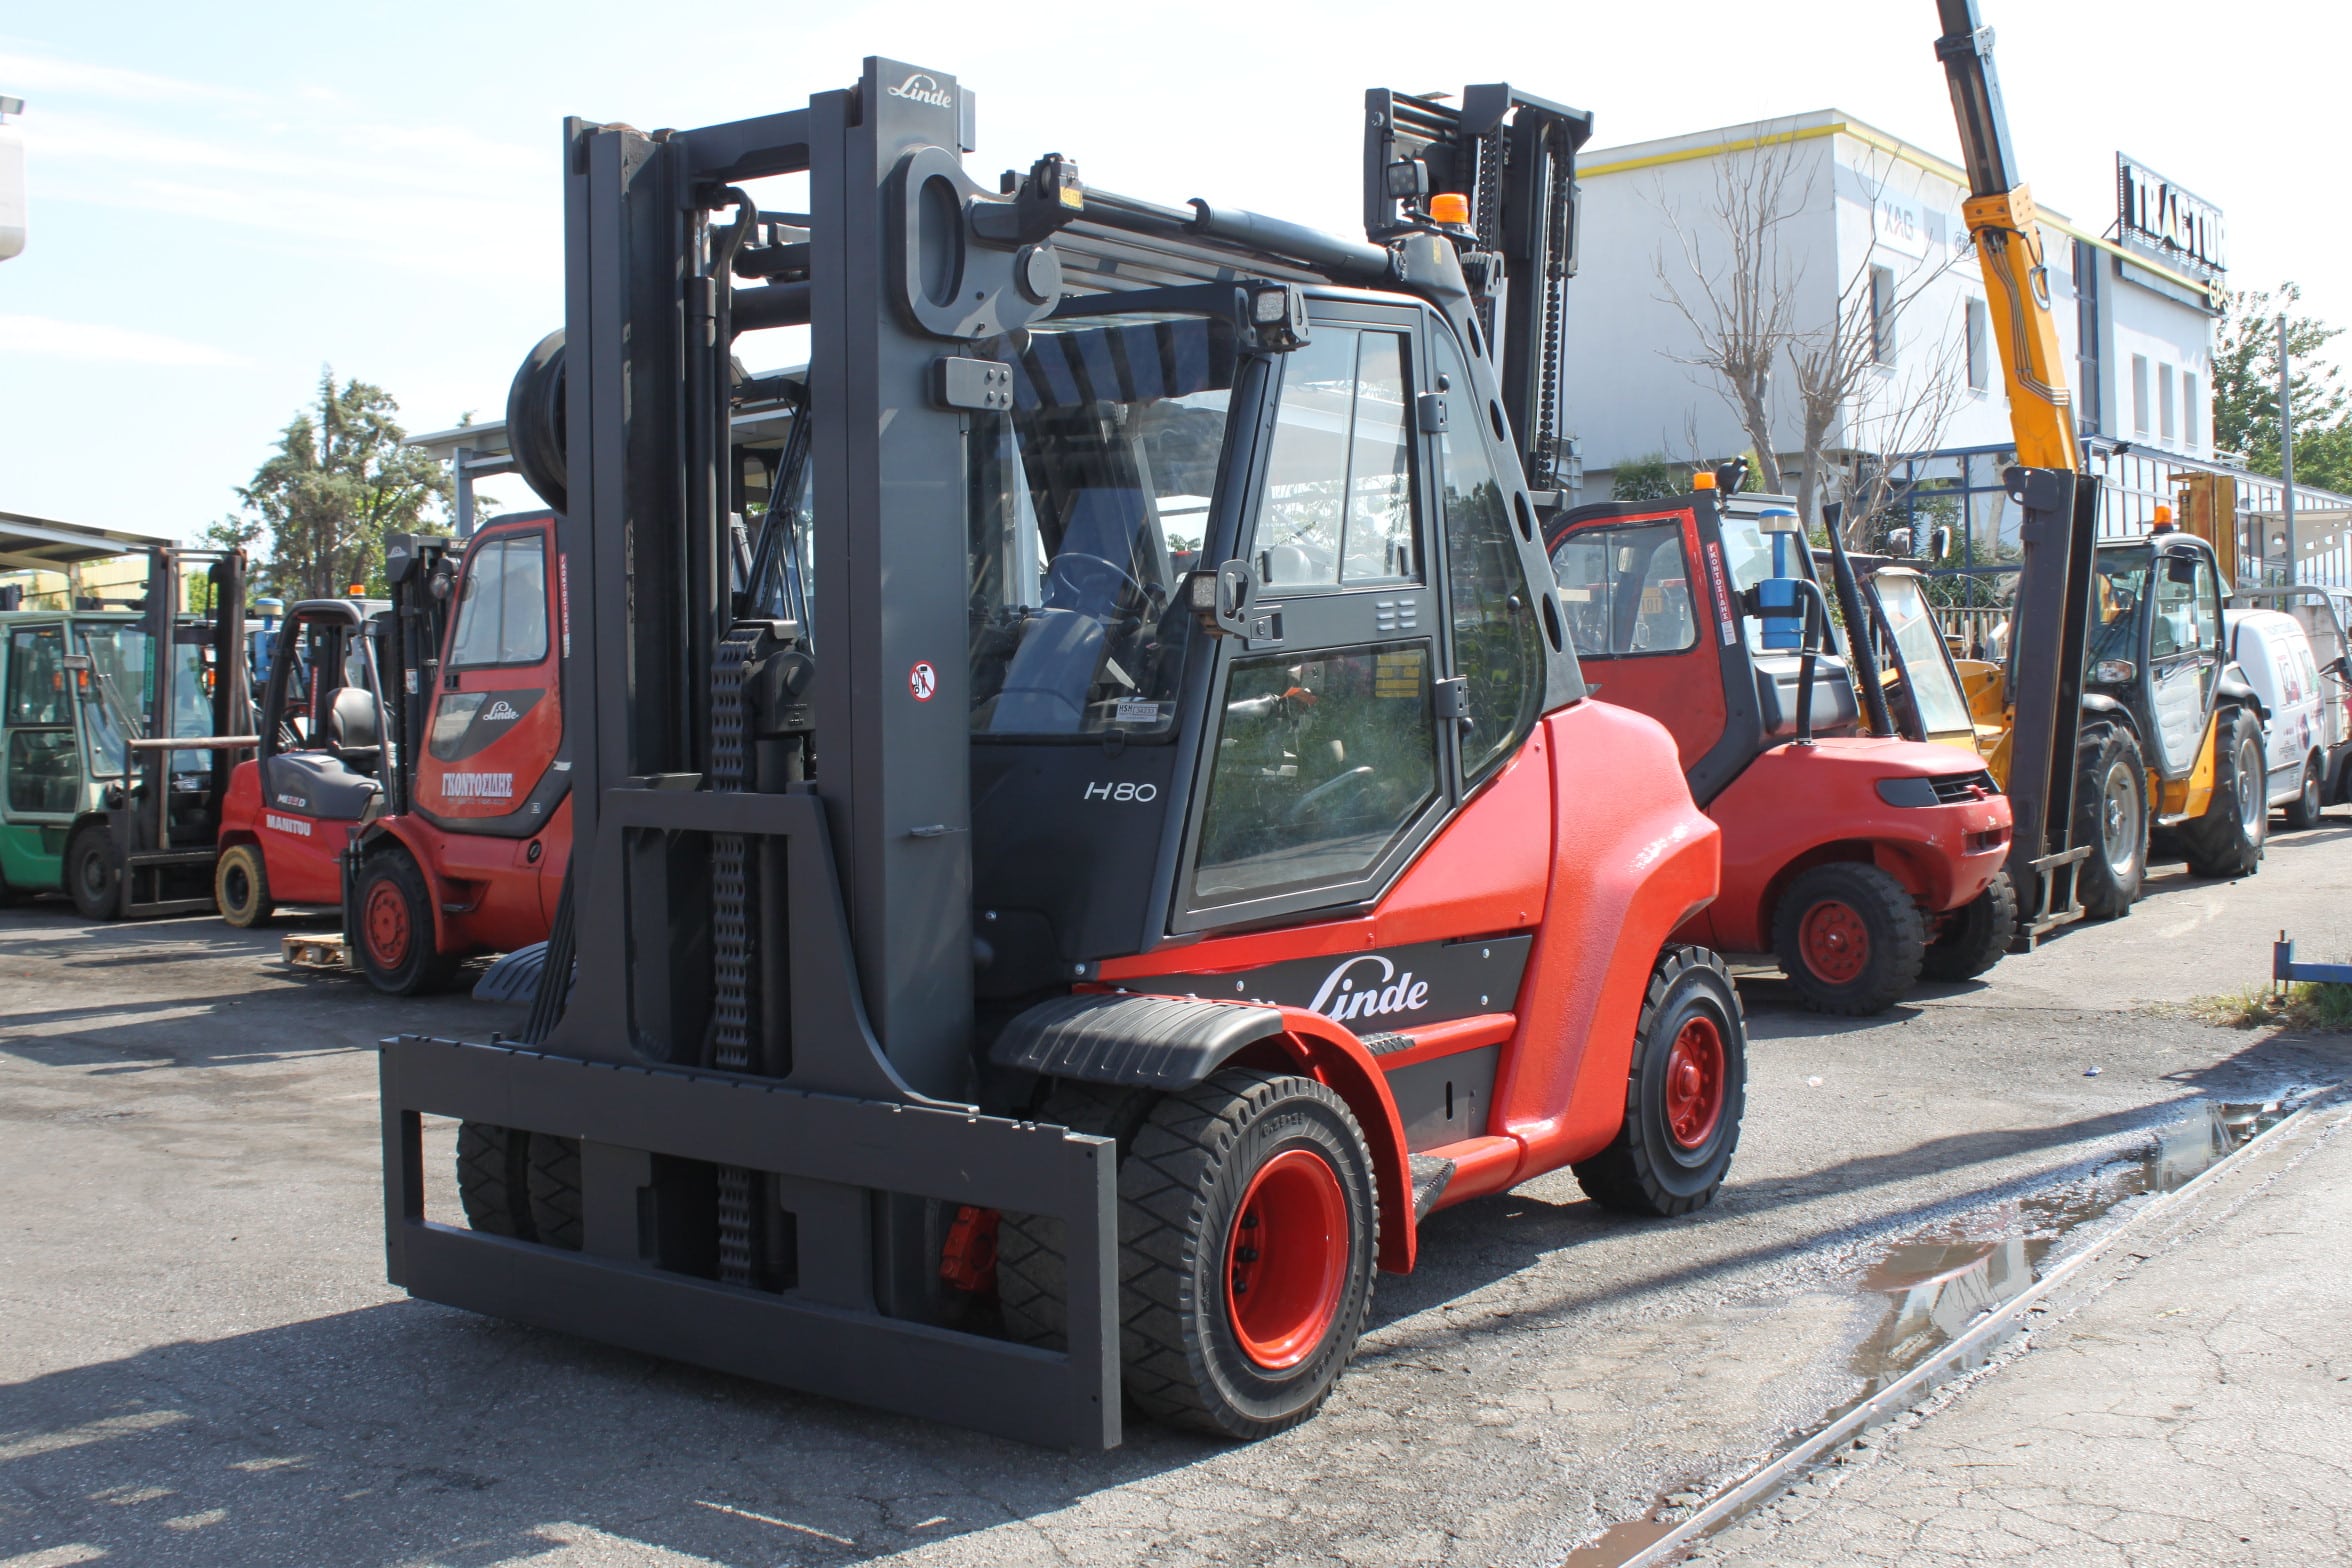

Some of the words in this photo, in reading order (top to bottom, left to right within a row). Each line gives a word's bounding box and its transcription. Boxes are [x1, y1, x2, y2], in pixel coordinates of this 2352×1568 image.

[886, 74, 952, 108] Linde
[1883, 201, 1914, 241] XAG
[2122, 165, 2226, 272] TRACTOR
[483, 701, 519, 720] Linde
[441, 772, 513, 798] ΓΚΟΝΤΟΣΙΔΗΣ
[1083, 782, 1157, 802] H80
[266, 814, 311, 837] MANITOU
[1307, 955, 1429, 1023] Linde
